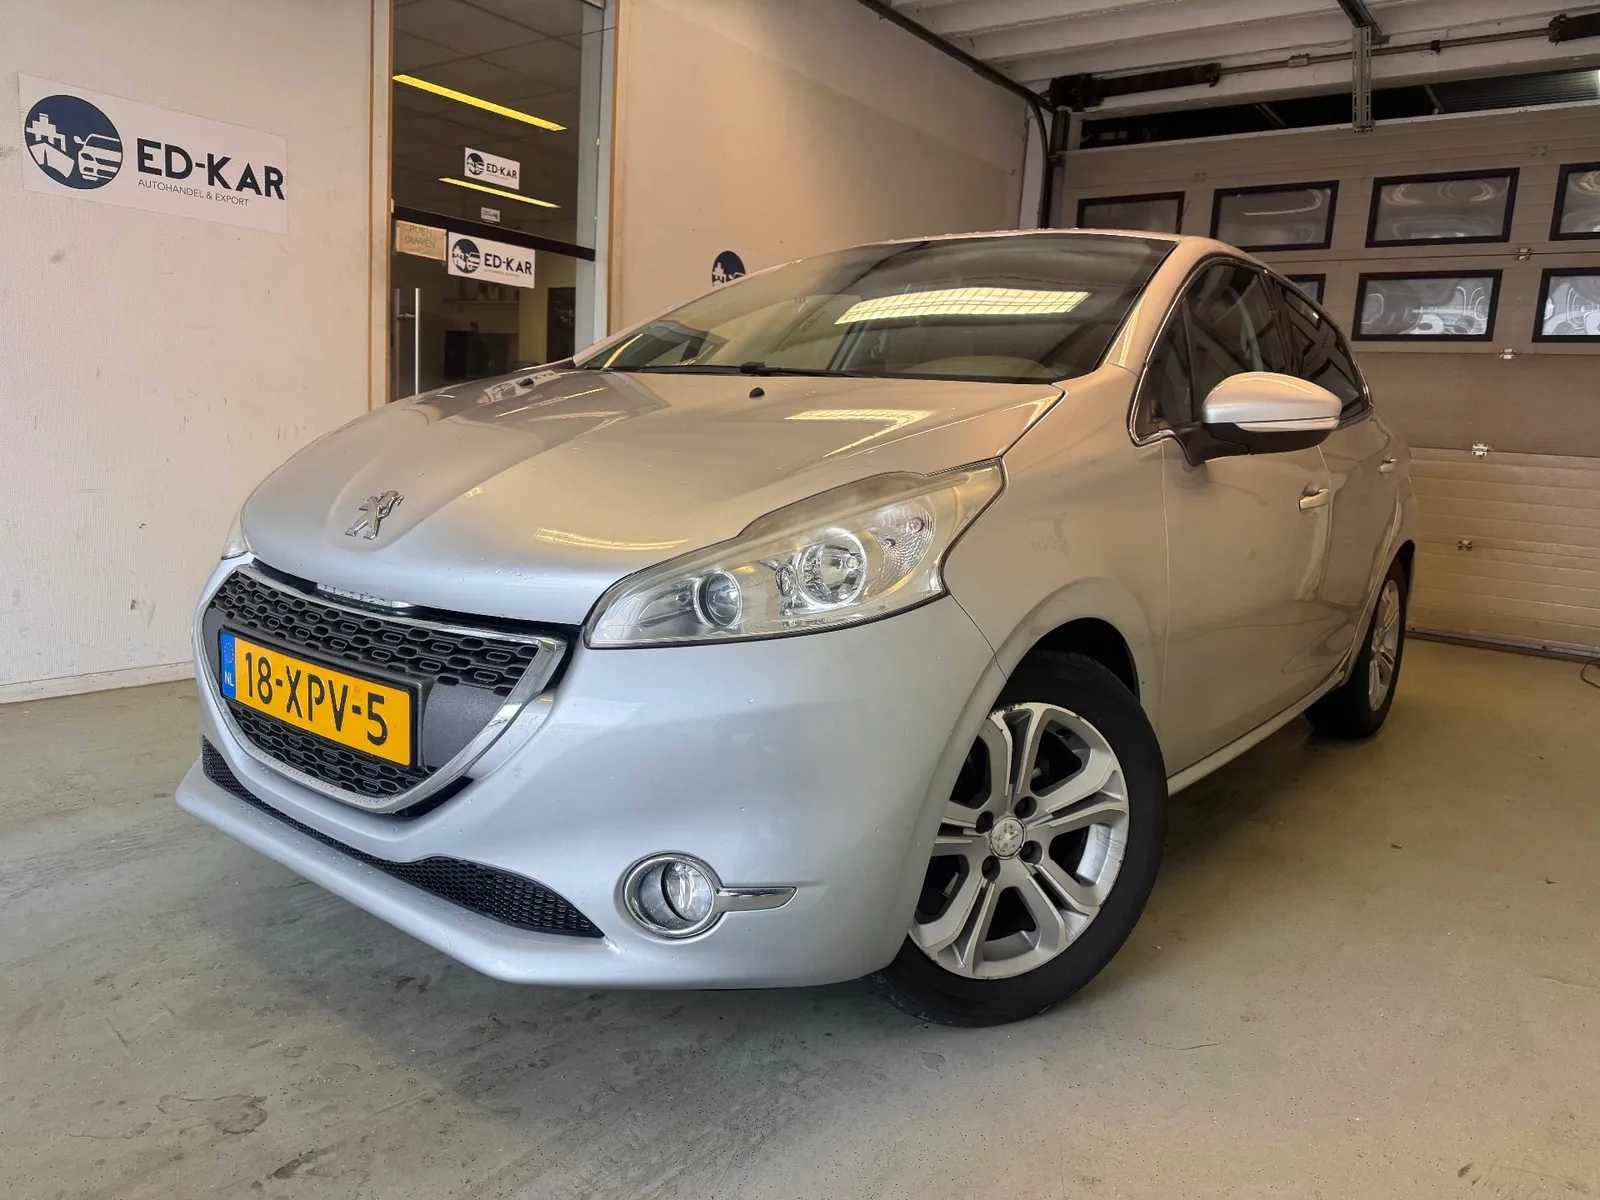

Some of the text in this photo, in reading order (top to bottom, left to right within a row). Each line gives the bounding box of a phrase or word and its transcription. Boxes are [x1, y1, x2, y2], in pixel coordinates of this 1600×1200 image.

[137, 137, 285, 200] ED-KAR
[486, 162, 518, 180] ED-KAR
[137, 178, 249, 207] AUTOHANDEL & EXPORT
[484, 252, 532, 275] ED-KAR
[224, 670, 235, 687] NL
[245, 652, 388, 746] 18-XPV-5
